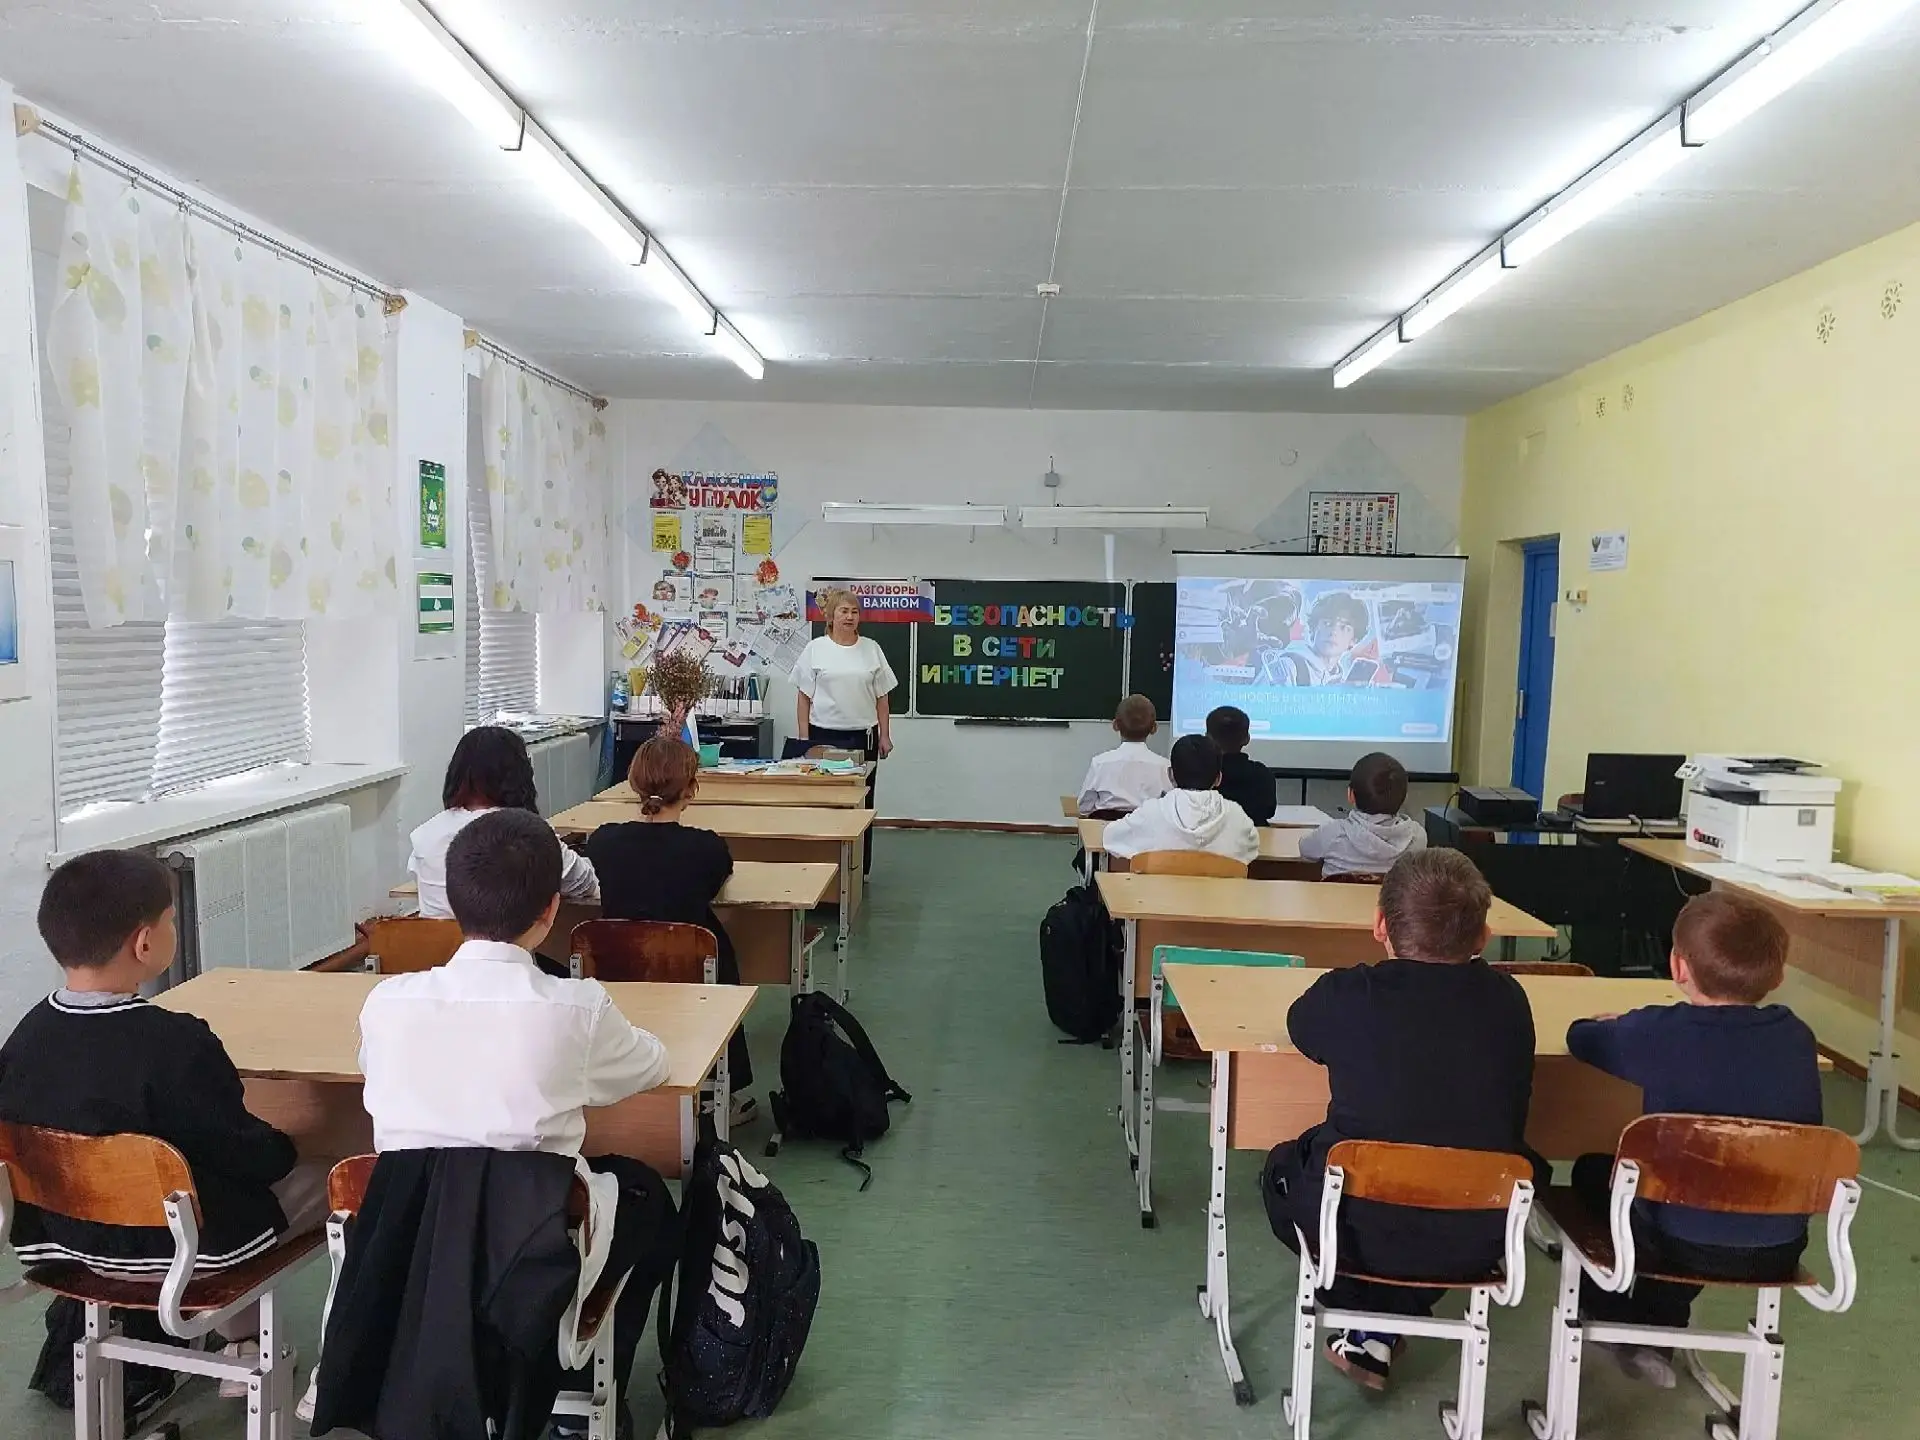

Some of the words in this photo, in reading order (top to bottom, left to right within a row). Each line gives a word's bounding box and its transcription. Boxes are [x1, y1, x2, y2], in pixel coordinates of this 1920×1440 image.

[681, 470, 778, 490] КЛАССНЫЙ
[688, 489, 764, 511] УГОЛОК
[850, 584, 919, 595] РАЗГОВОРЫ
[863, 597, 920, 609] ВАЖНОМ
[934, 605, 1136, 629] БЕЗОПАСНОСТЬ
[953, 634, 973, 657] В
[982, 636, 1056, 659] СЕТИ
[921, 664, 1064, 689] ИНТЕРНЕТ
[708, 1174, 756, 1329] JUST
